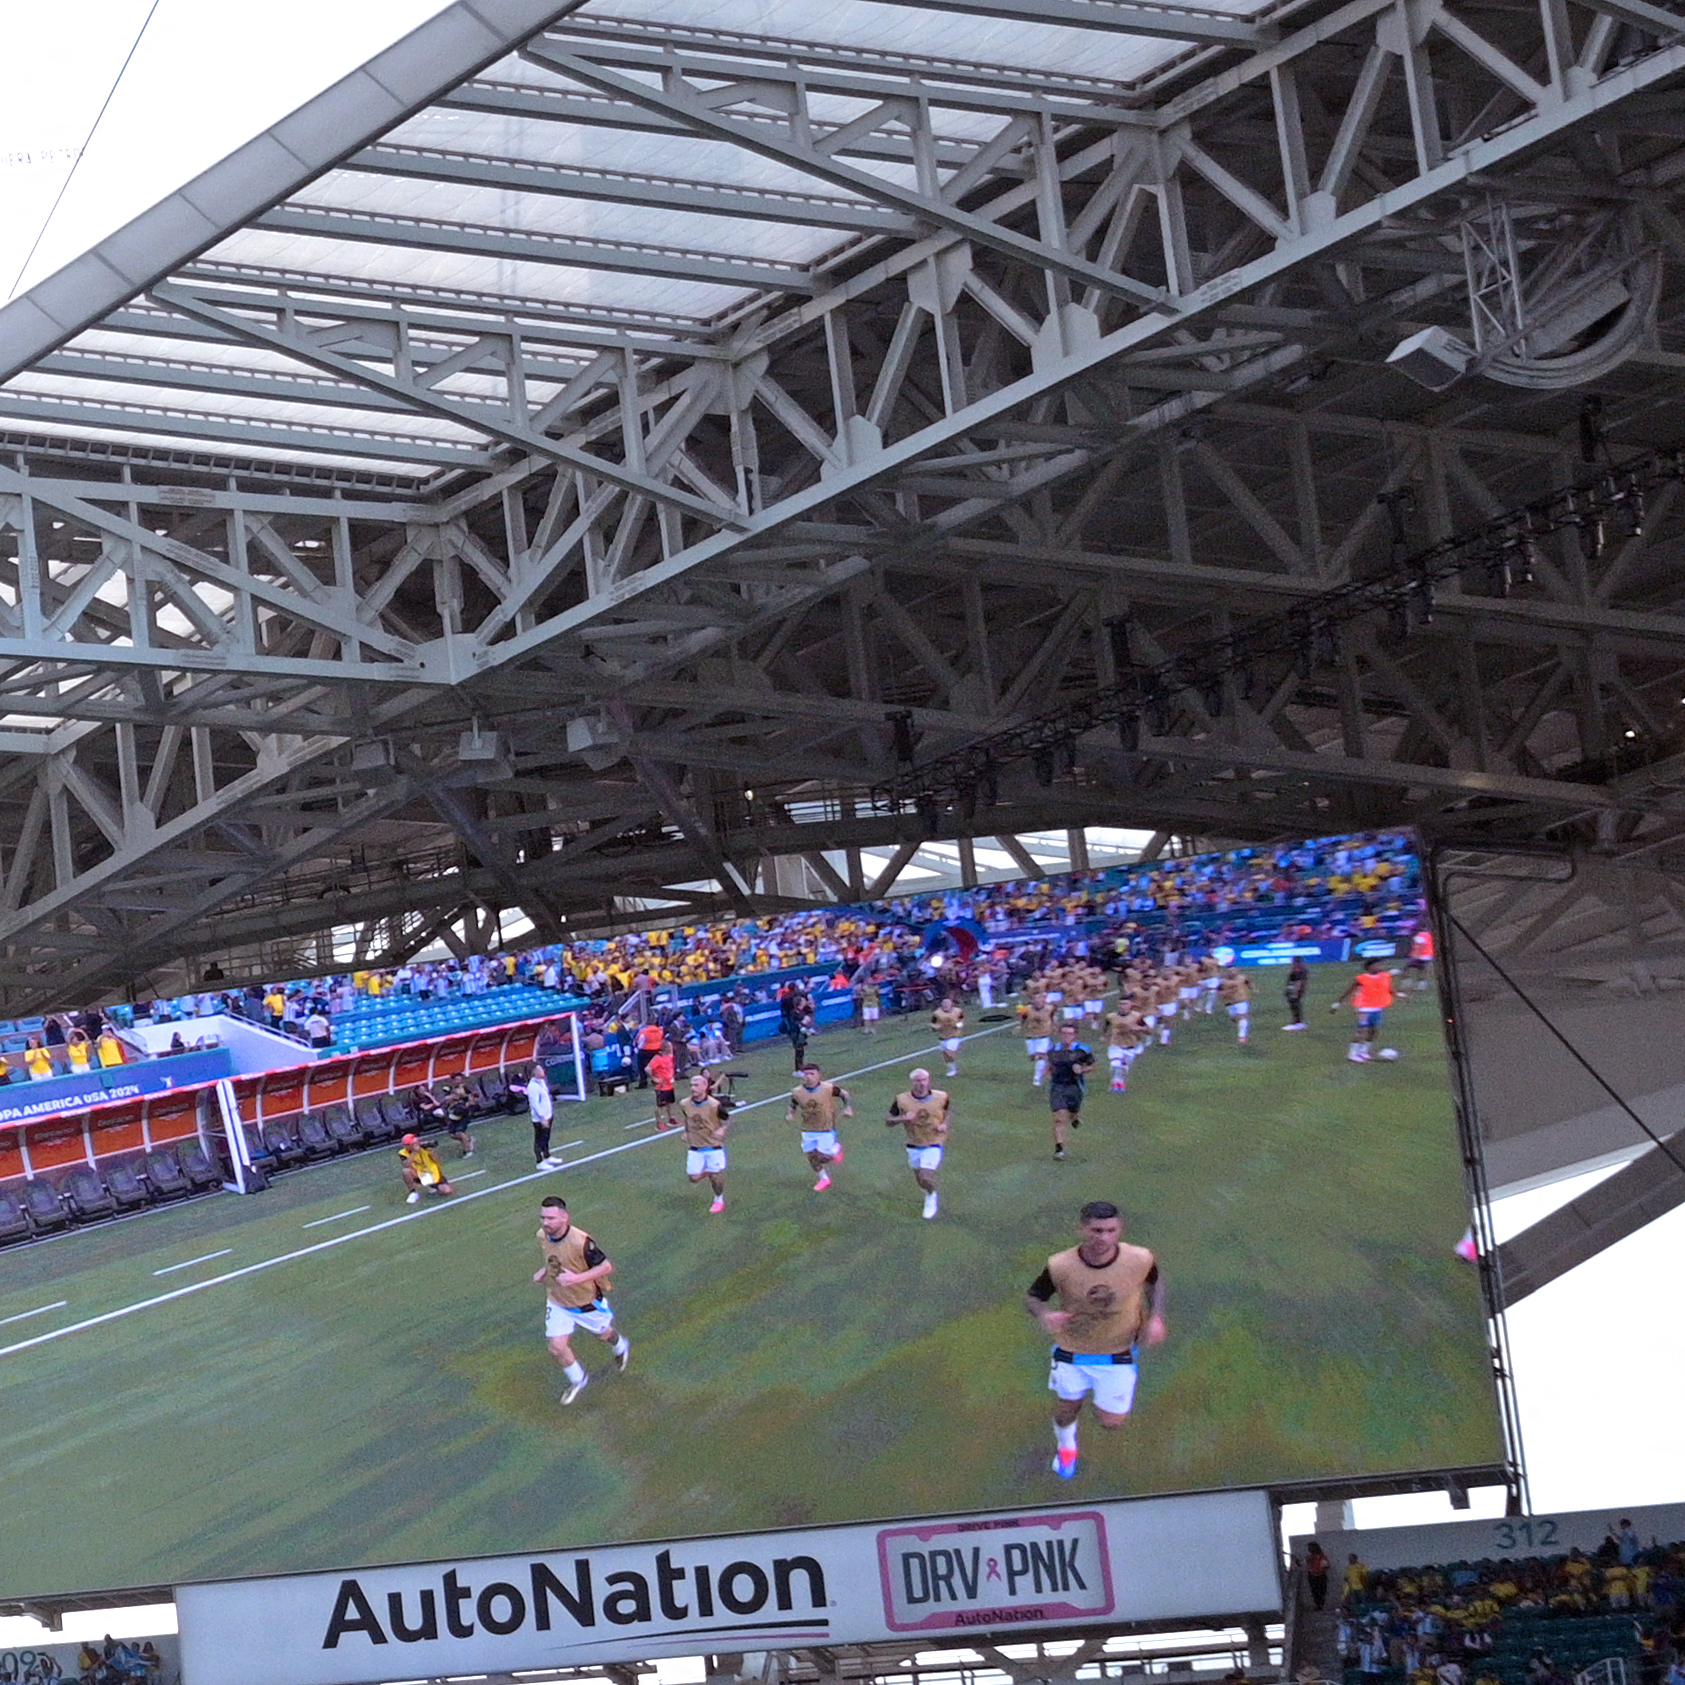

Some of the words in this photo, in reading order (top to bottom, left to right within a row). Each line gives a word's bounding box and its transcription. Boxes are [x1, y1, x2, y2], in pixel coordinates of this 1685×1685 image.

[24, 1095, 83, 1115] AMERICA
[84, 1092, 108, 1104] USA
[109, 1085, 139, 1100] 2024
[1495, 1519, 1560, 1549] 312
[902, 1546, 980, 1604] DRV
[1003, 1537, 1087, 1596] PNK
[322, 1548, 828, 1650] AutoNation
[955, 1608, 1043, 1626] AutoNation
